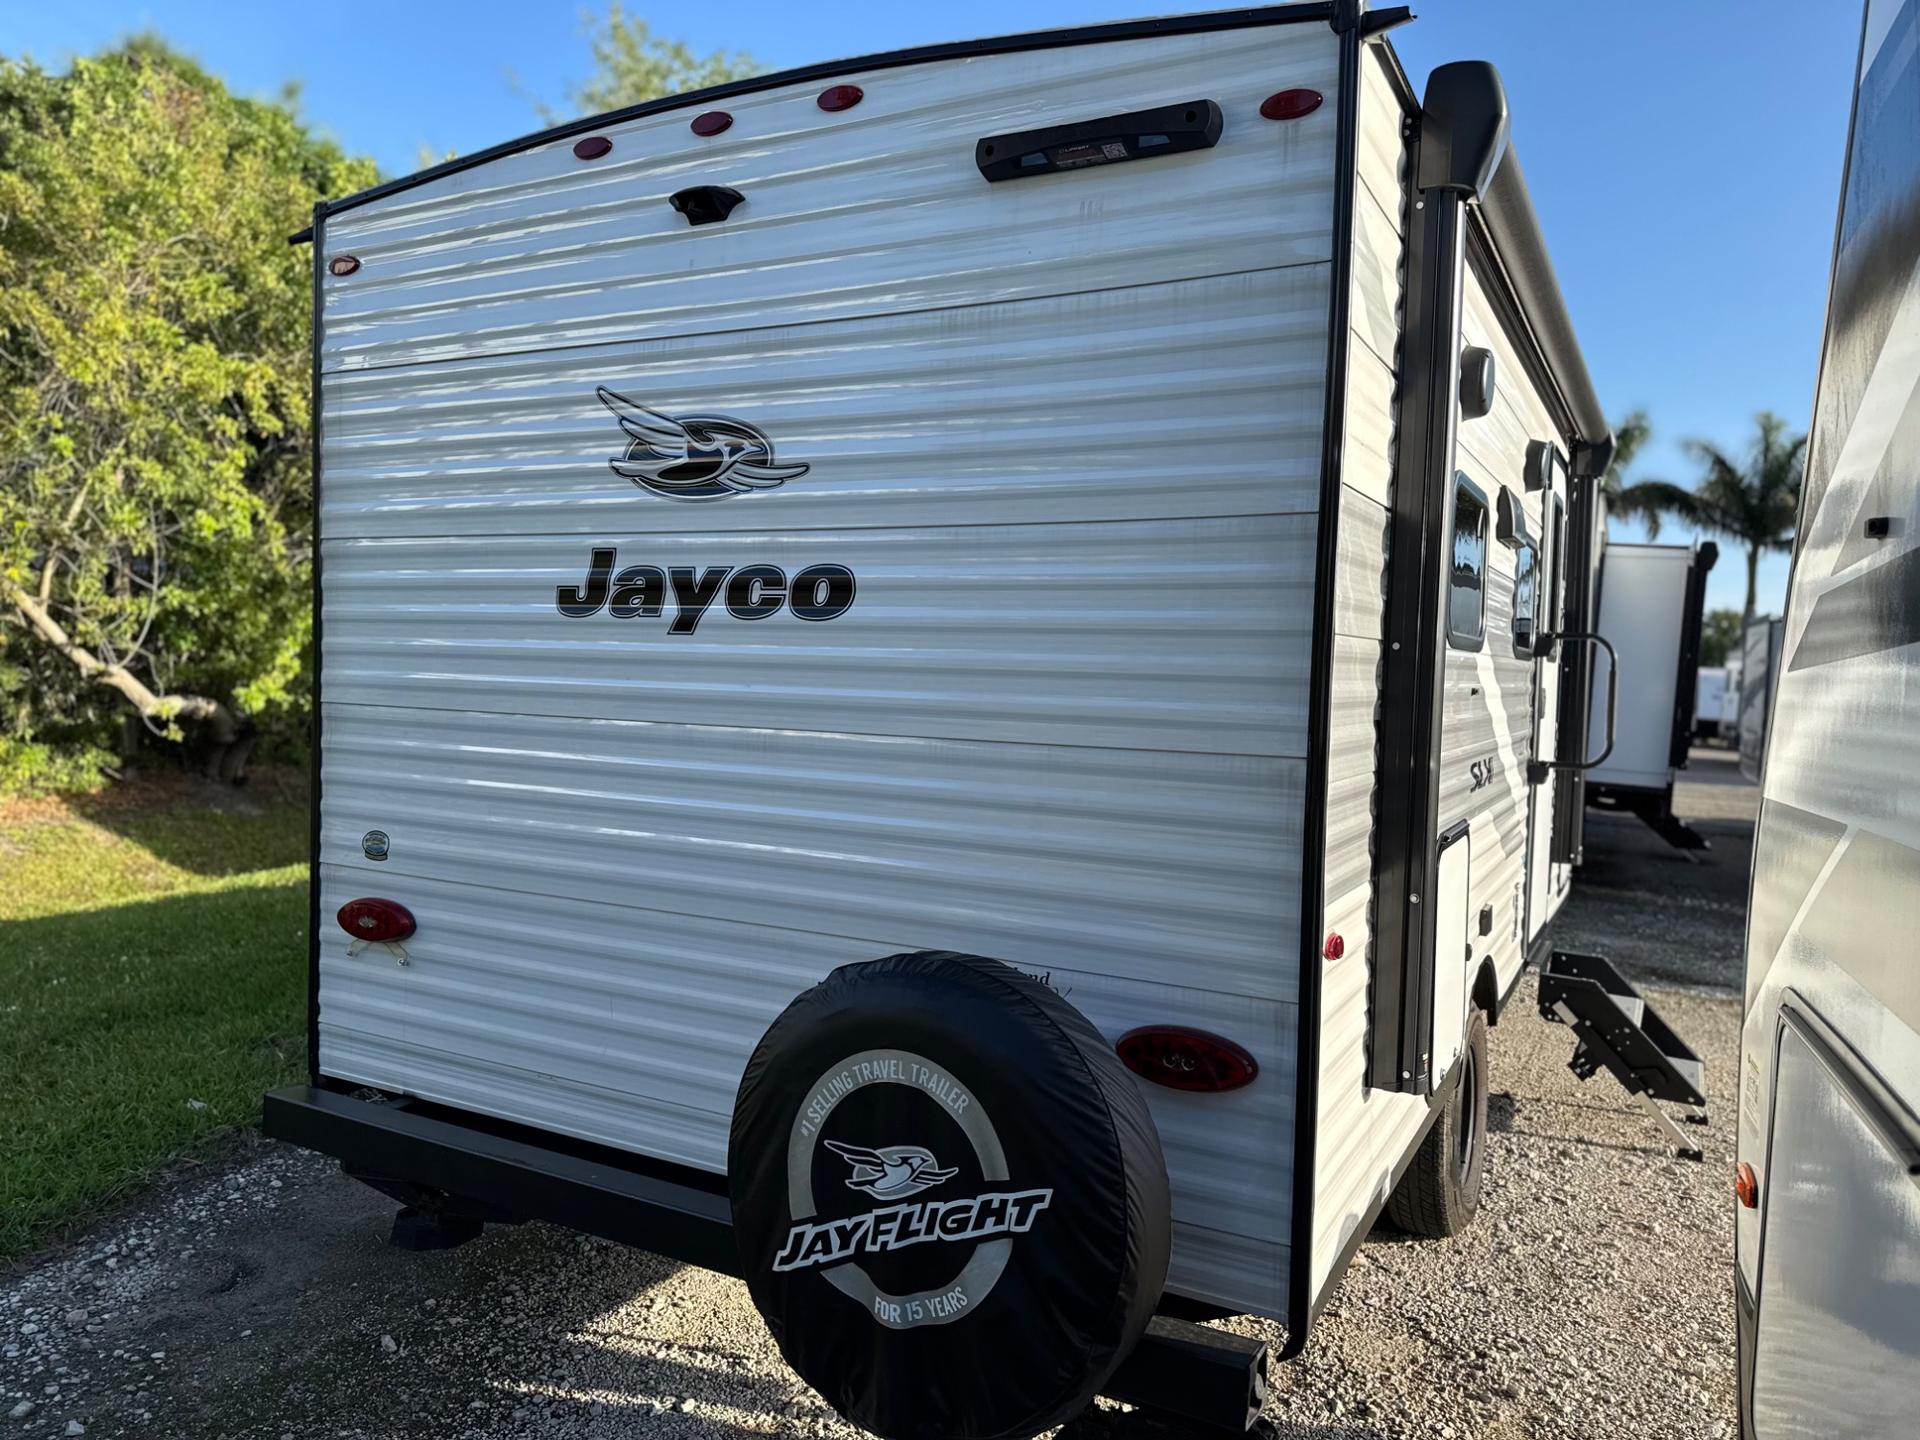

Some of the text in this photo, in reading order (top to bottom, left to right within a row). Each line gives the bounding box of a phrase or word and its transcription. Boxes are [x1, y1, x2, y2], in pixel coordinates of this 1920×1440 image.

[556, 547, 857, 636] Jayco
[1470, 756, 1494, 793] SLX
[800, 1059, 970, 1137] #1 SELLING TRAVEL TRAILER
[874, 1286, 968, 1324] FOR 15 YEARS
